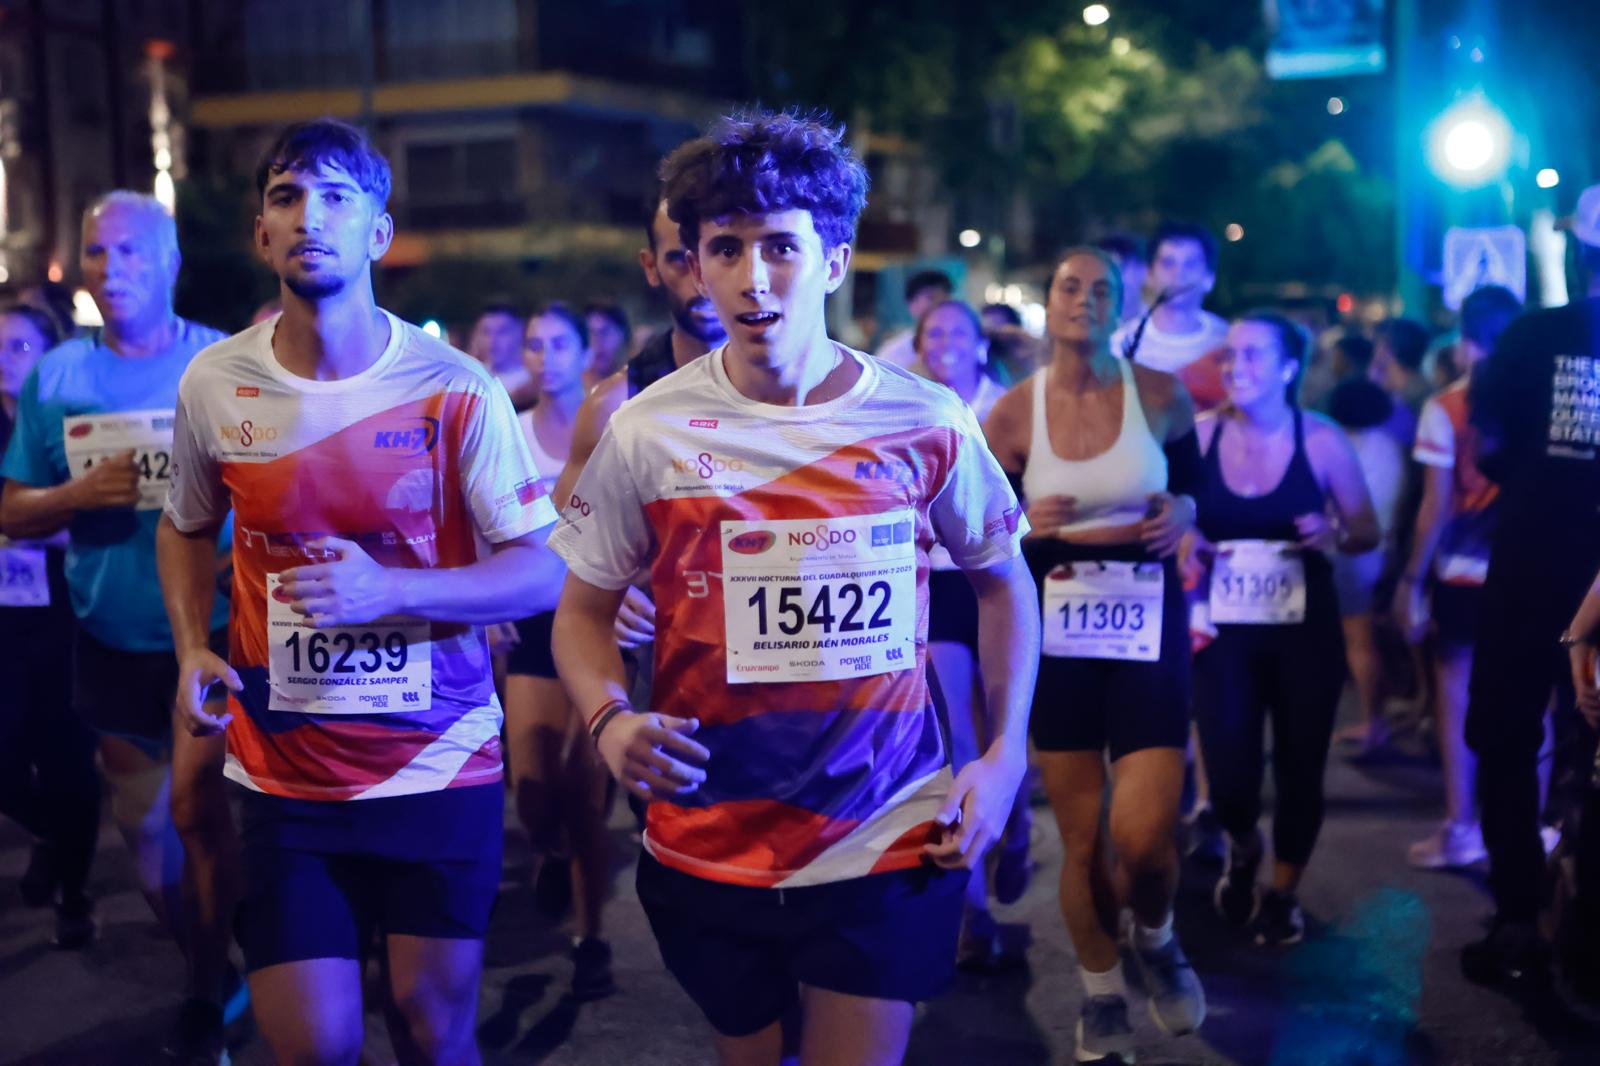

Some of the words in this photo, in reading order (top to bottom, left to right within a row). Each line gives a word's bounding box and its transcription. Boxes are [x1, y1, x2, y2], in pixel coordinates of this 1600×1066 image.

[758, 575, 801, 583] NOCTURNA
[803, 574, 818, 582] DEL
[819, 569, 877, 581] GUADALQUIVIR
[896, 565, 913, 574] 2025
[748, 580, 893, 636] 15422
[1058, 602, 1145, 631] 11303
[753, 639, 811, 650] BELISARIO
[812, 636, 839, 649] JAÉN
[841, 633, 890, 647] MORALES
[285, 631, 409, 674] 16239
[839, 655, 872, 667] POWER
[287, 676, 318, 685] SERGIO
[319, 675, 368, 686] GONZÁLEZ
[369, 676, 409, 685] SAMPER
[358, 694, 389, 702] POWER
